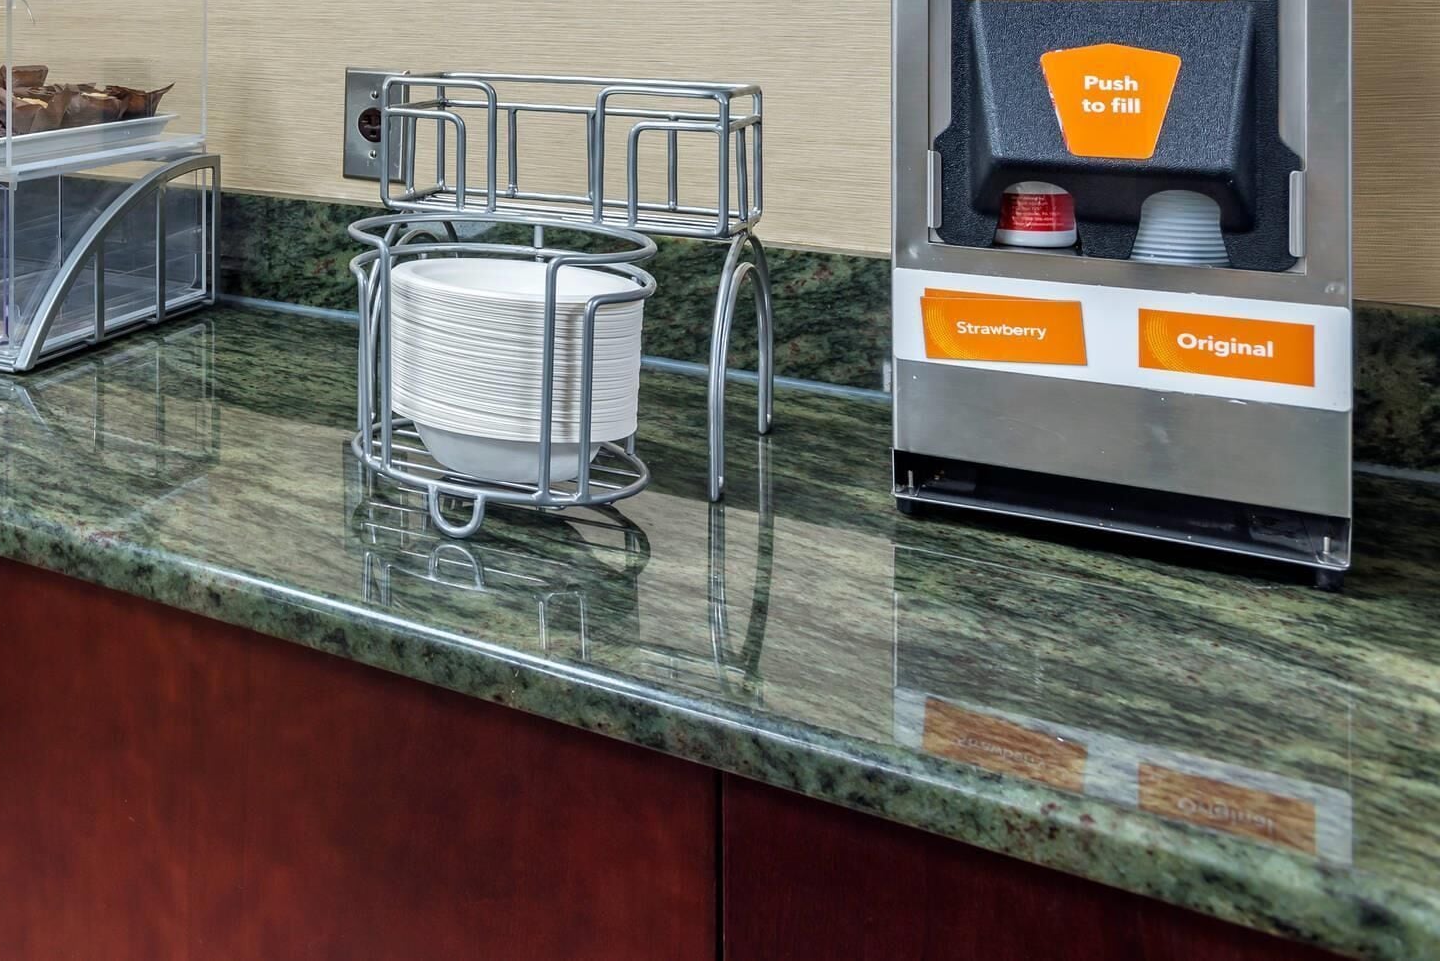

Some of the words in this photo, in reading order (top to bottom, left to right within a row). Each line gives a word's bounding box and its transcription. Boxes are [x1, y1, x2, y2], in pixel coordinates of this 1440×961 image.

[1084, 75, 1138, 91] Push
[1082, 98, 1105, 113] to
[1111, 97, 1141, 113] fill
[956, 320, 1047, 341] Strawberry
[1176, 332, 1274, 359] Original
